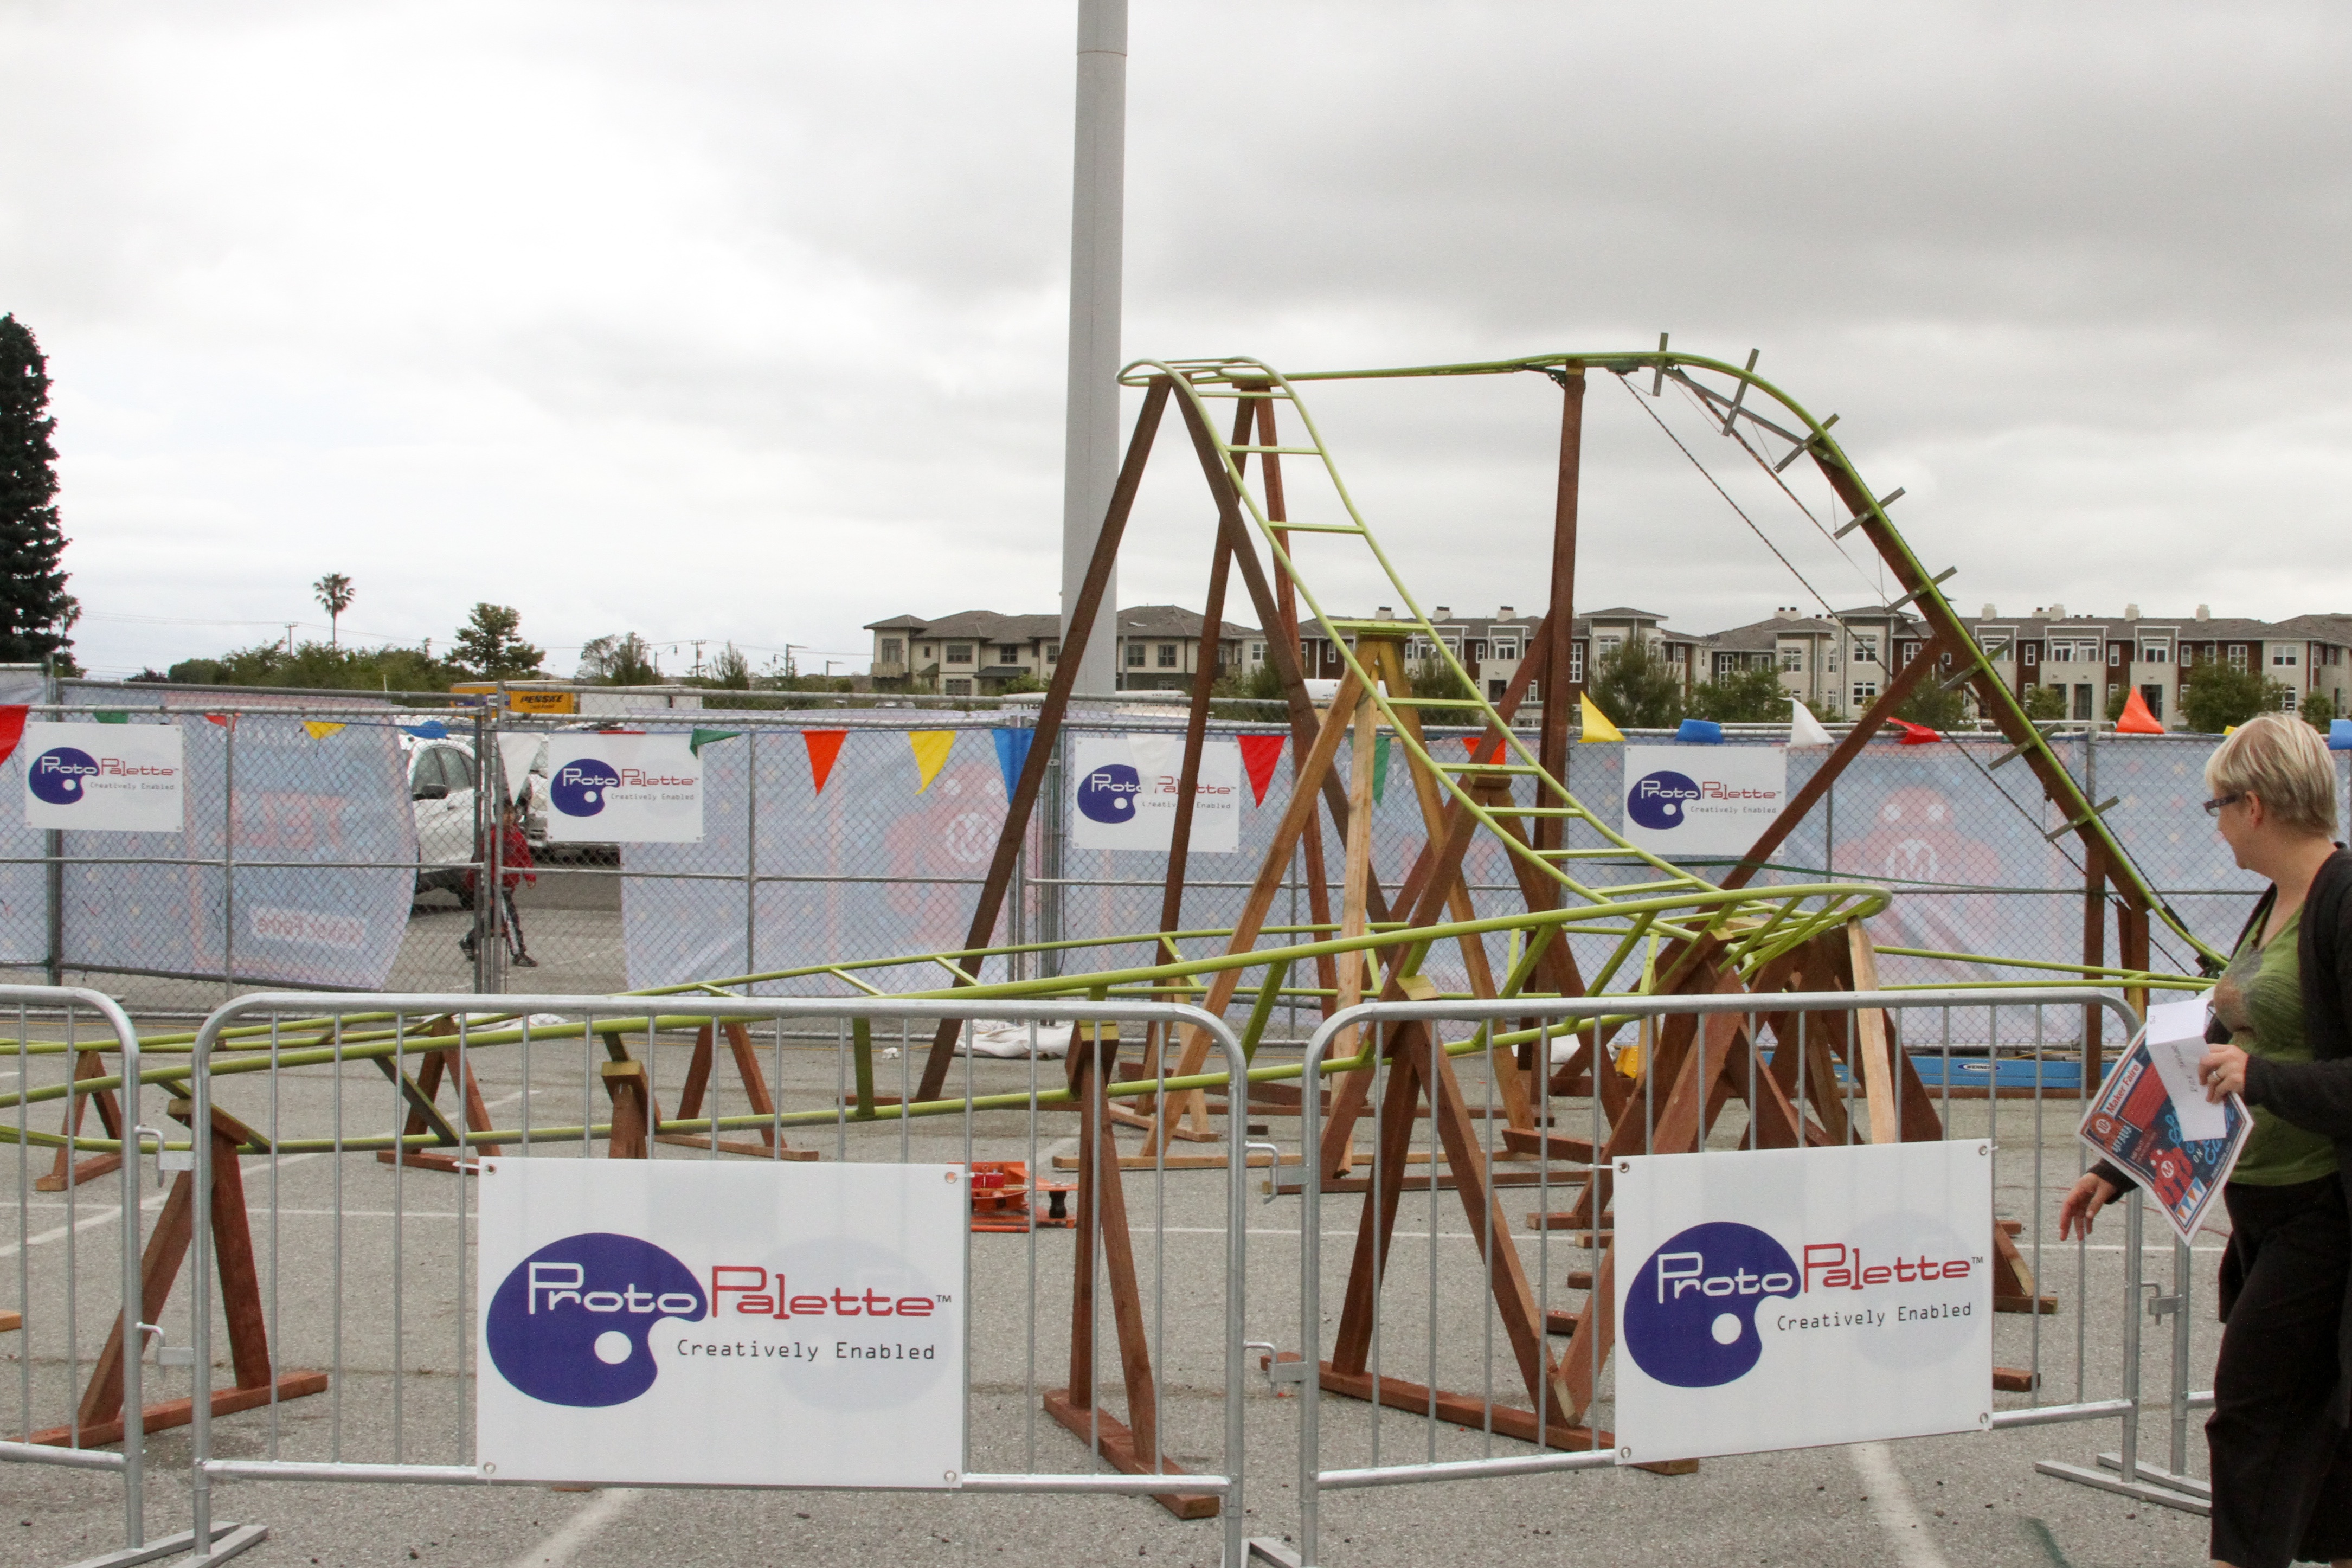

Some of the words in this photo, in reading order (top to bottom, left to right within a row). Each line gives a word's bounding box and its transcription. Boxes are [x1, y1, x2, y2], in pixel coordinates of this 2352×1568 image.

[520, 695, 564, 703] PENSKE
[2106, 1087, 2126, 1114] Maker
[2123, 1064, 2139, 1086] Faire
[2193, 1148, 2204, 1163] ON
[1777, 1309, 1886, 1332] Creatively
[1898, 1302, 1972, 1322] Enabled
[677, 1339, 819, 1361] Creatively
[836, 1342, 935, 1360] Enabled
